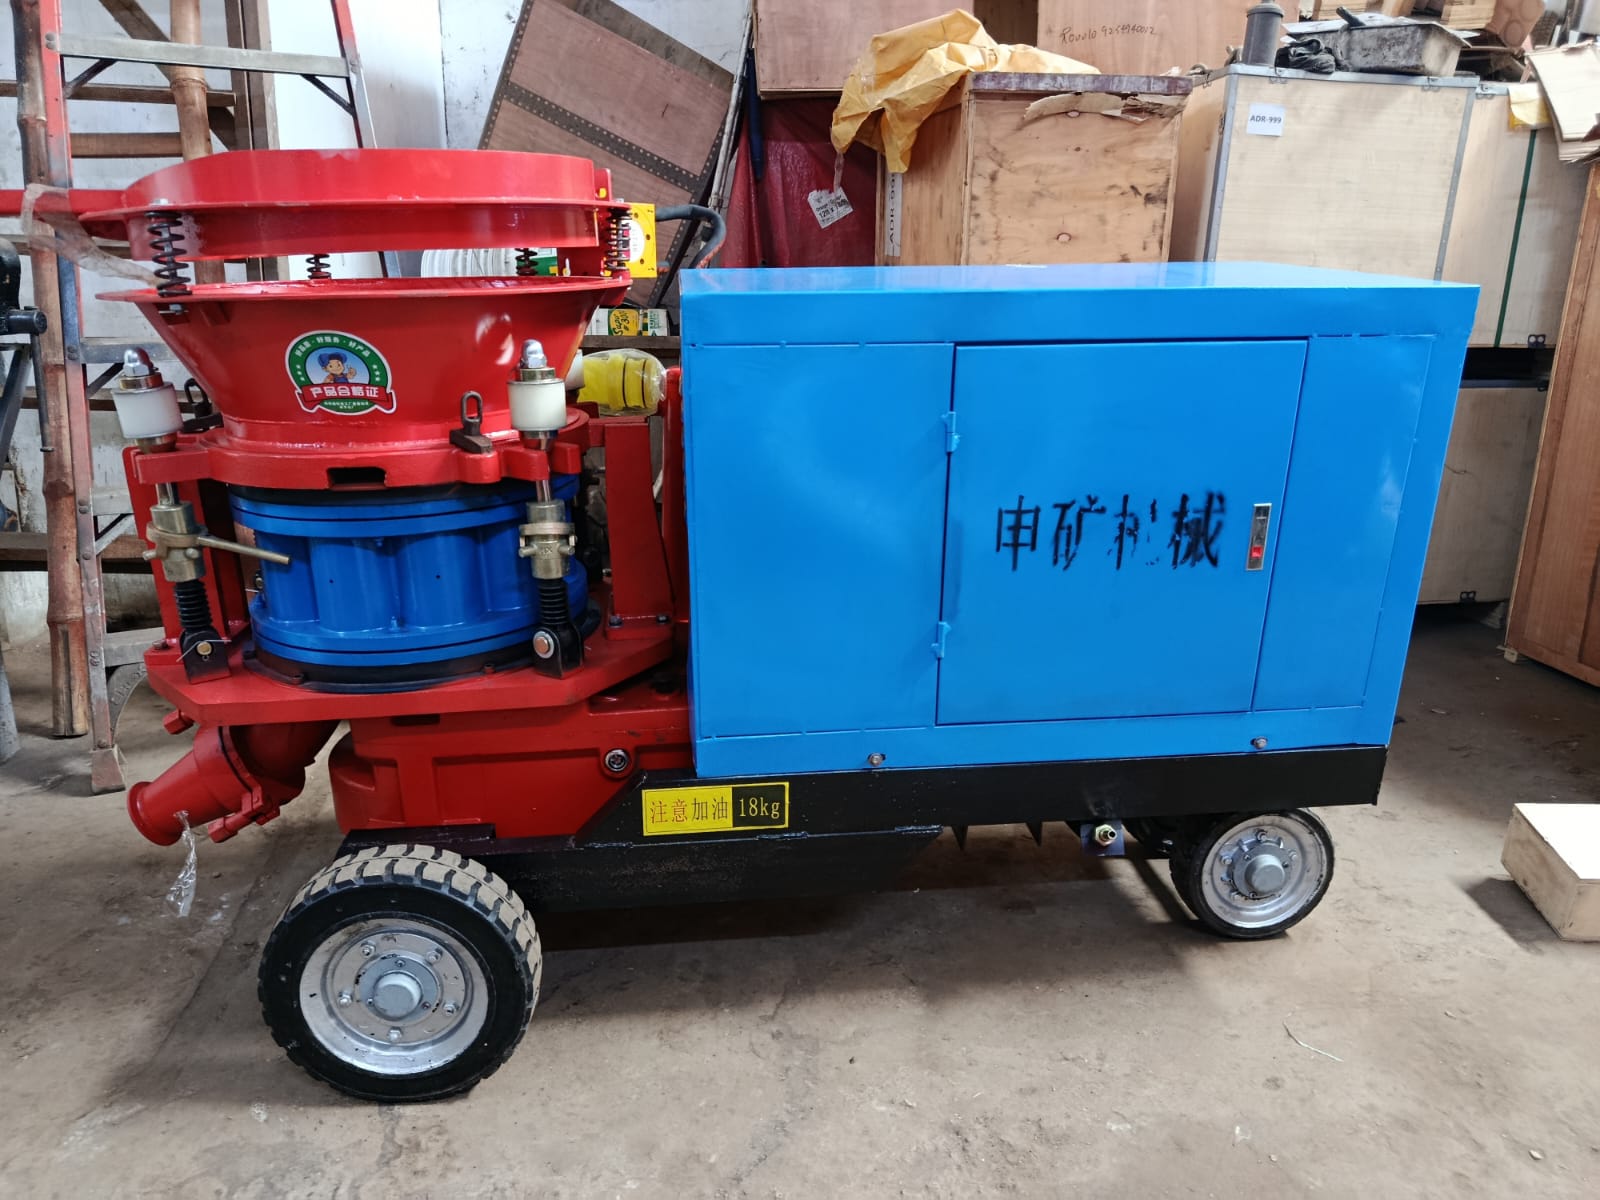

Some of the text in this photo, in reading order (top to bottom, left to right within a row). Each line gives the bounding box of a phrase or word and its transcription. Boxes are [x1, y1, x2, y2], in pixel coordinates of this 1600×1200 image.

[1250, 115, 1282, 124] ADR-999
[310, 385, 379, 398] 产品合格证
[650, 796, 781, 824] 注意加油 18kg
